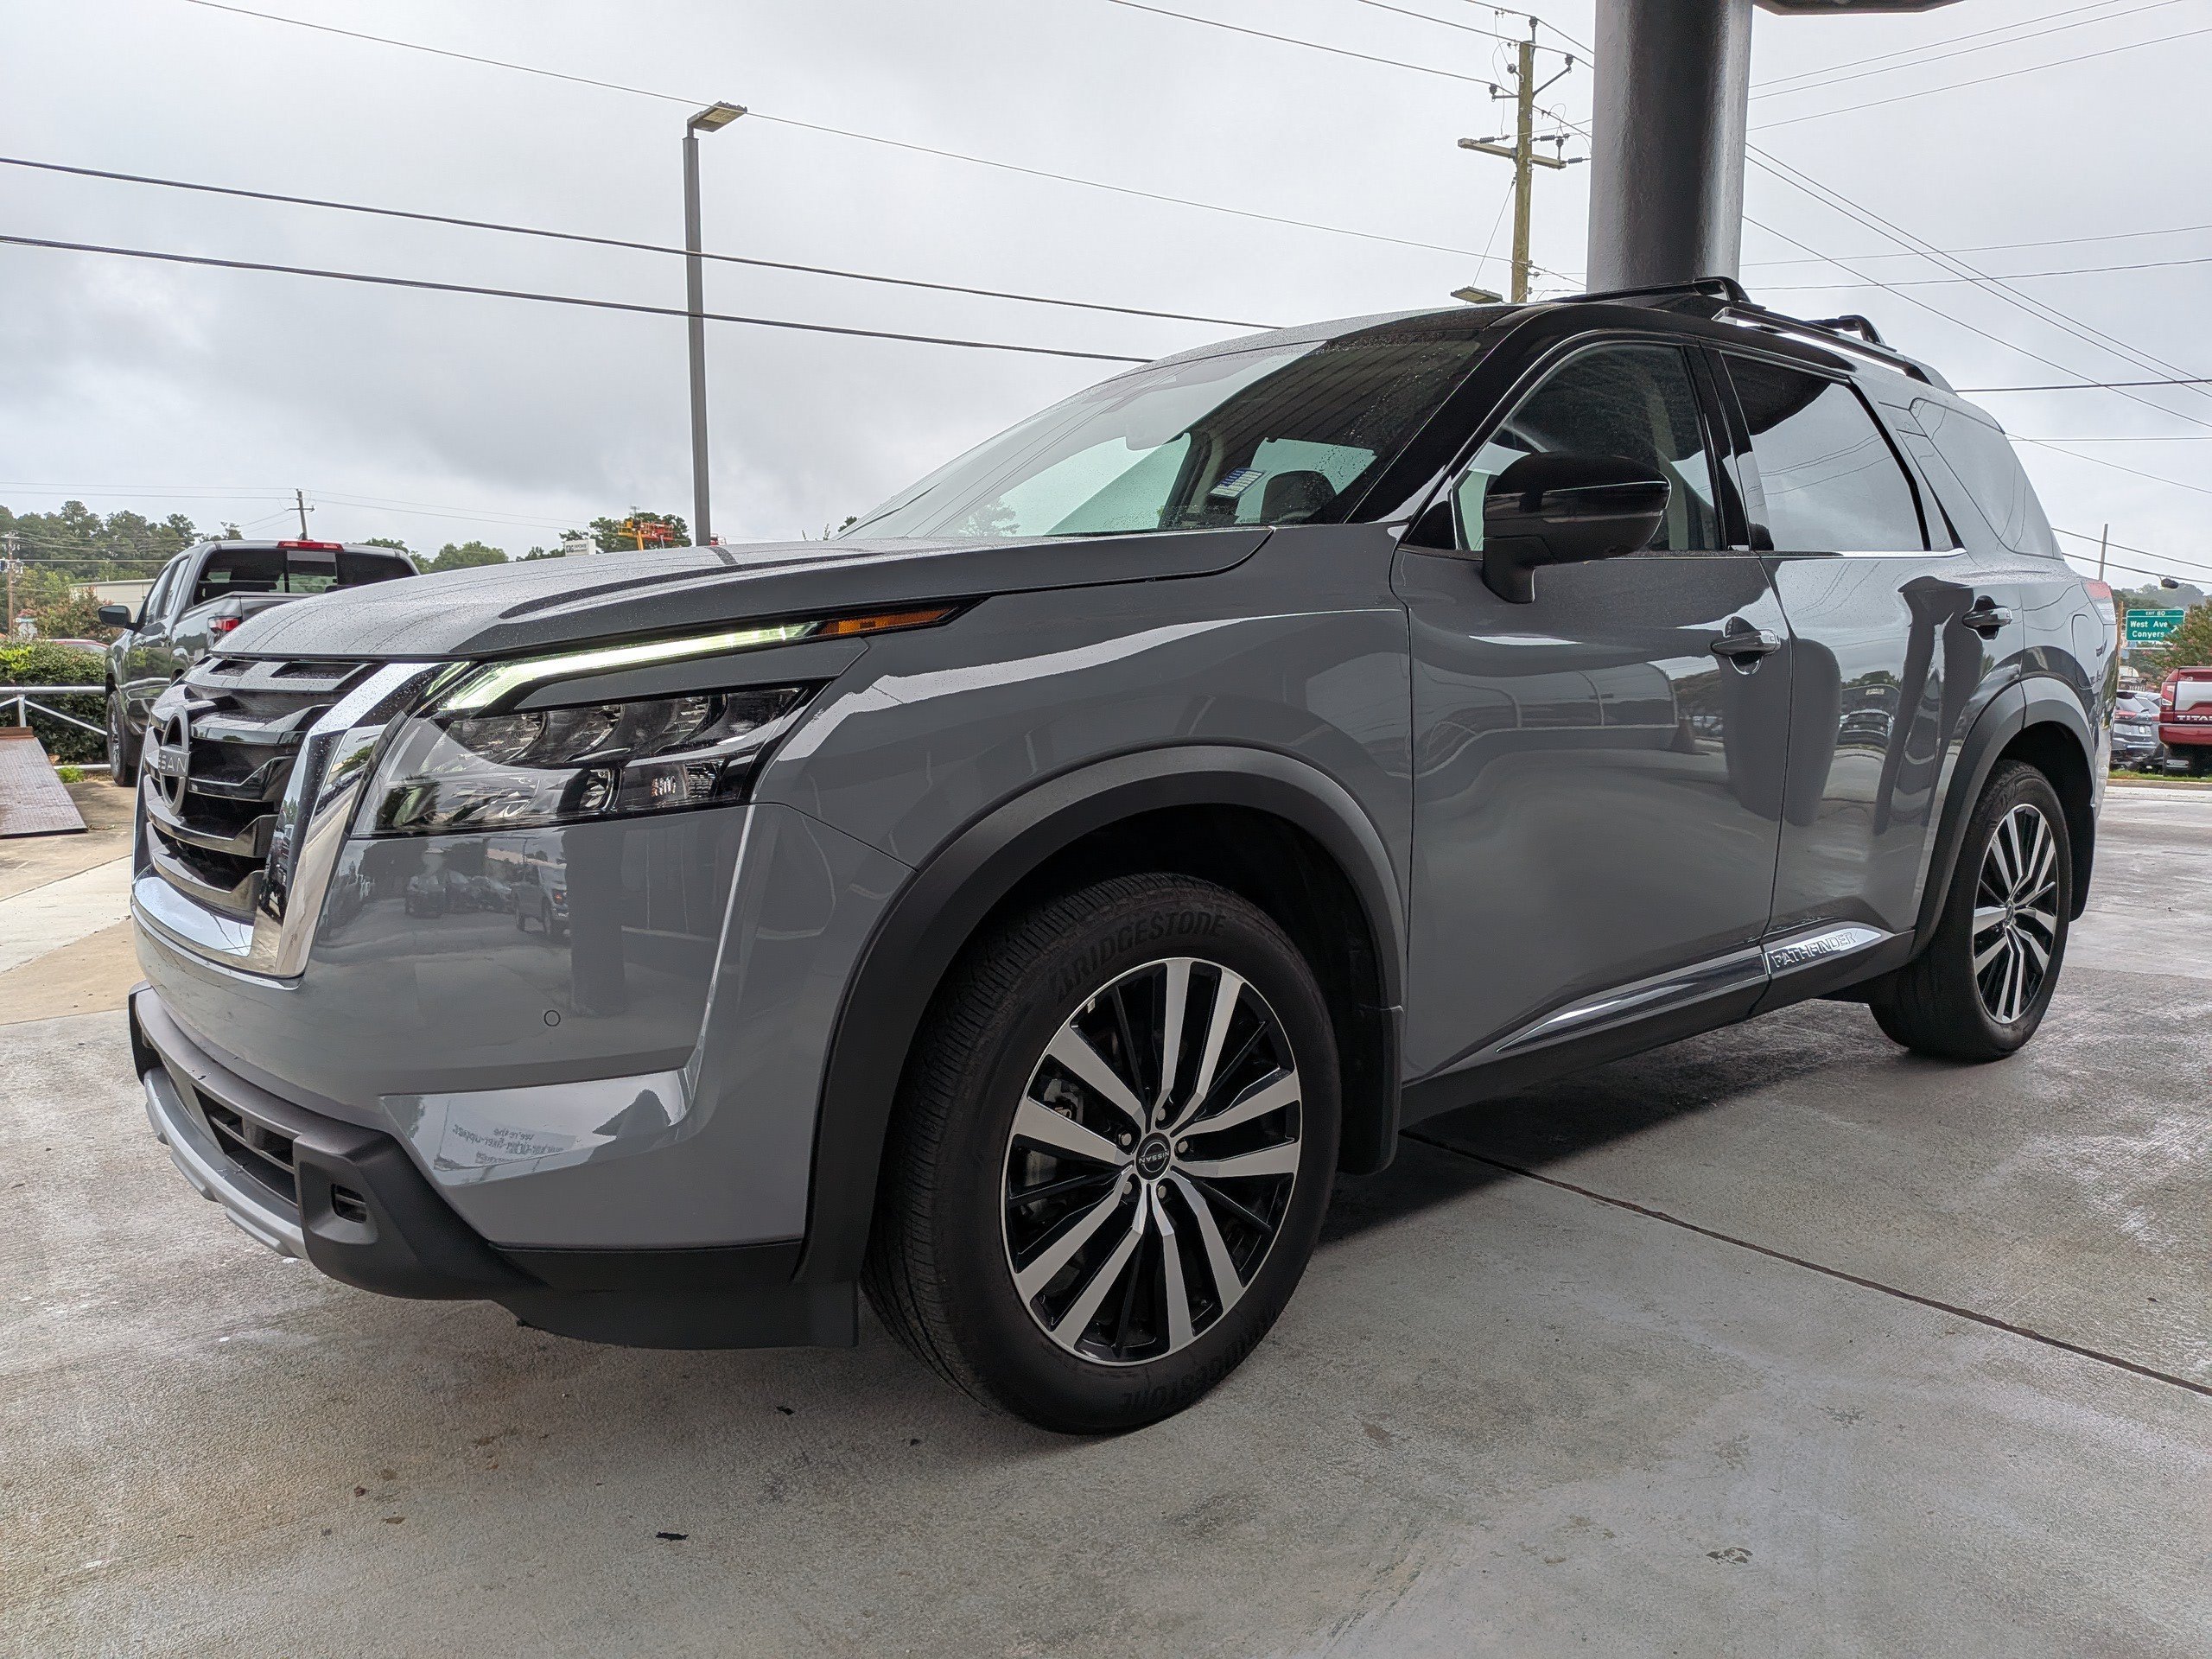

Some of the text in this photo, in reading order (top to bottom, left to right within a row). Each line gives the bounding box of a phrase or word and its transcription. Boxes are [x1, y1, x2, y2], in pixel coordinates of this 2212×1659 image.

[2132, 630, 2165, 639] Conyers
[1050, 912, 1226, 1003] BRIDGESTONE
[1773, 932, 1856, 967] PATHFINDER
[1139, 1152, 1169, 1164] NISSAN
